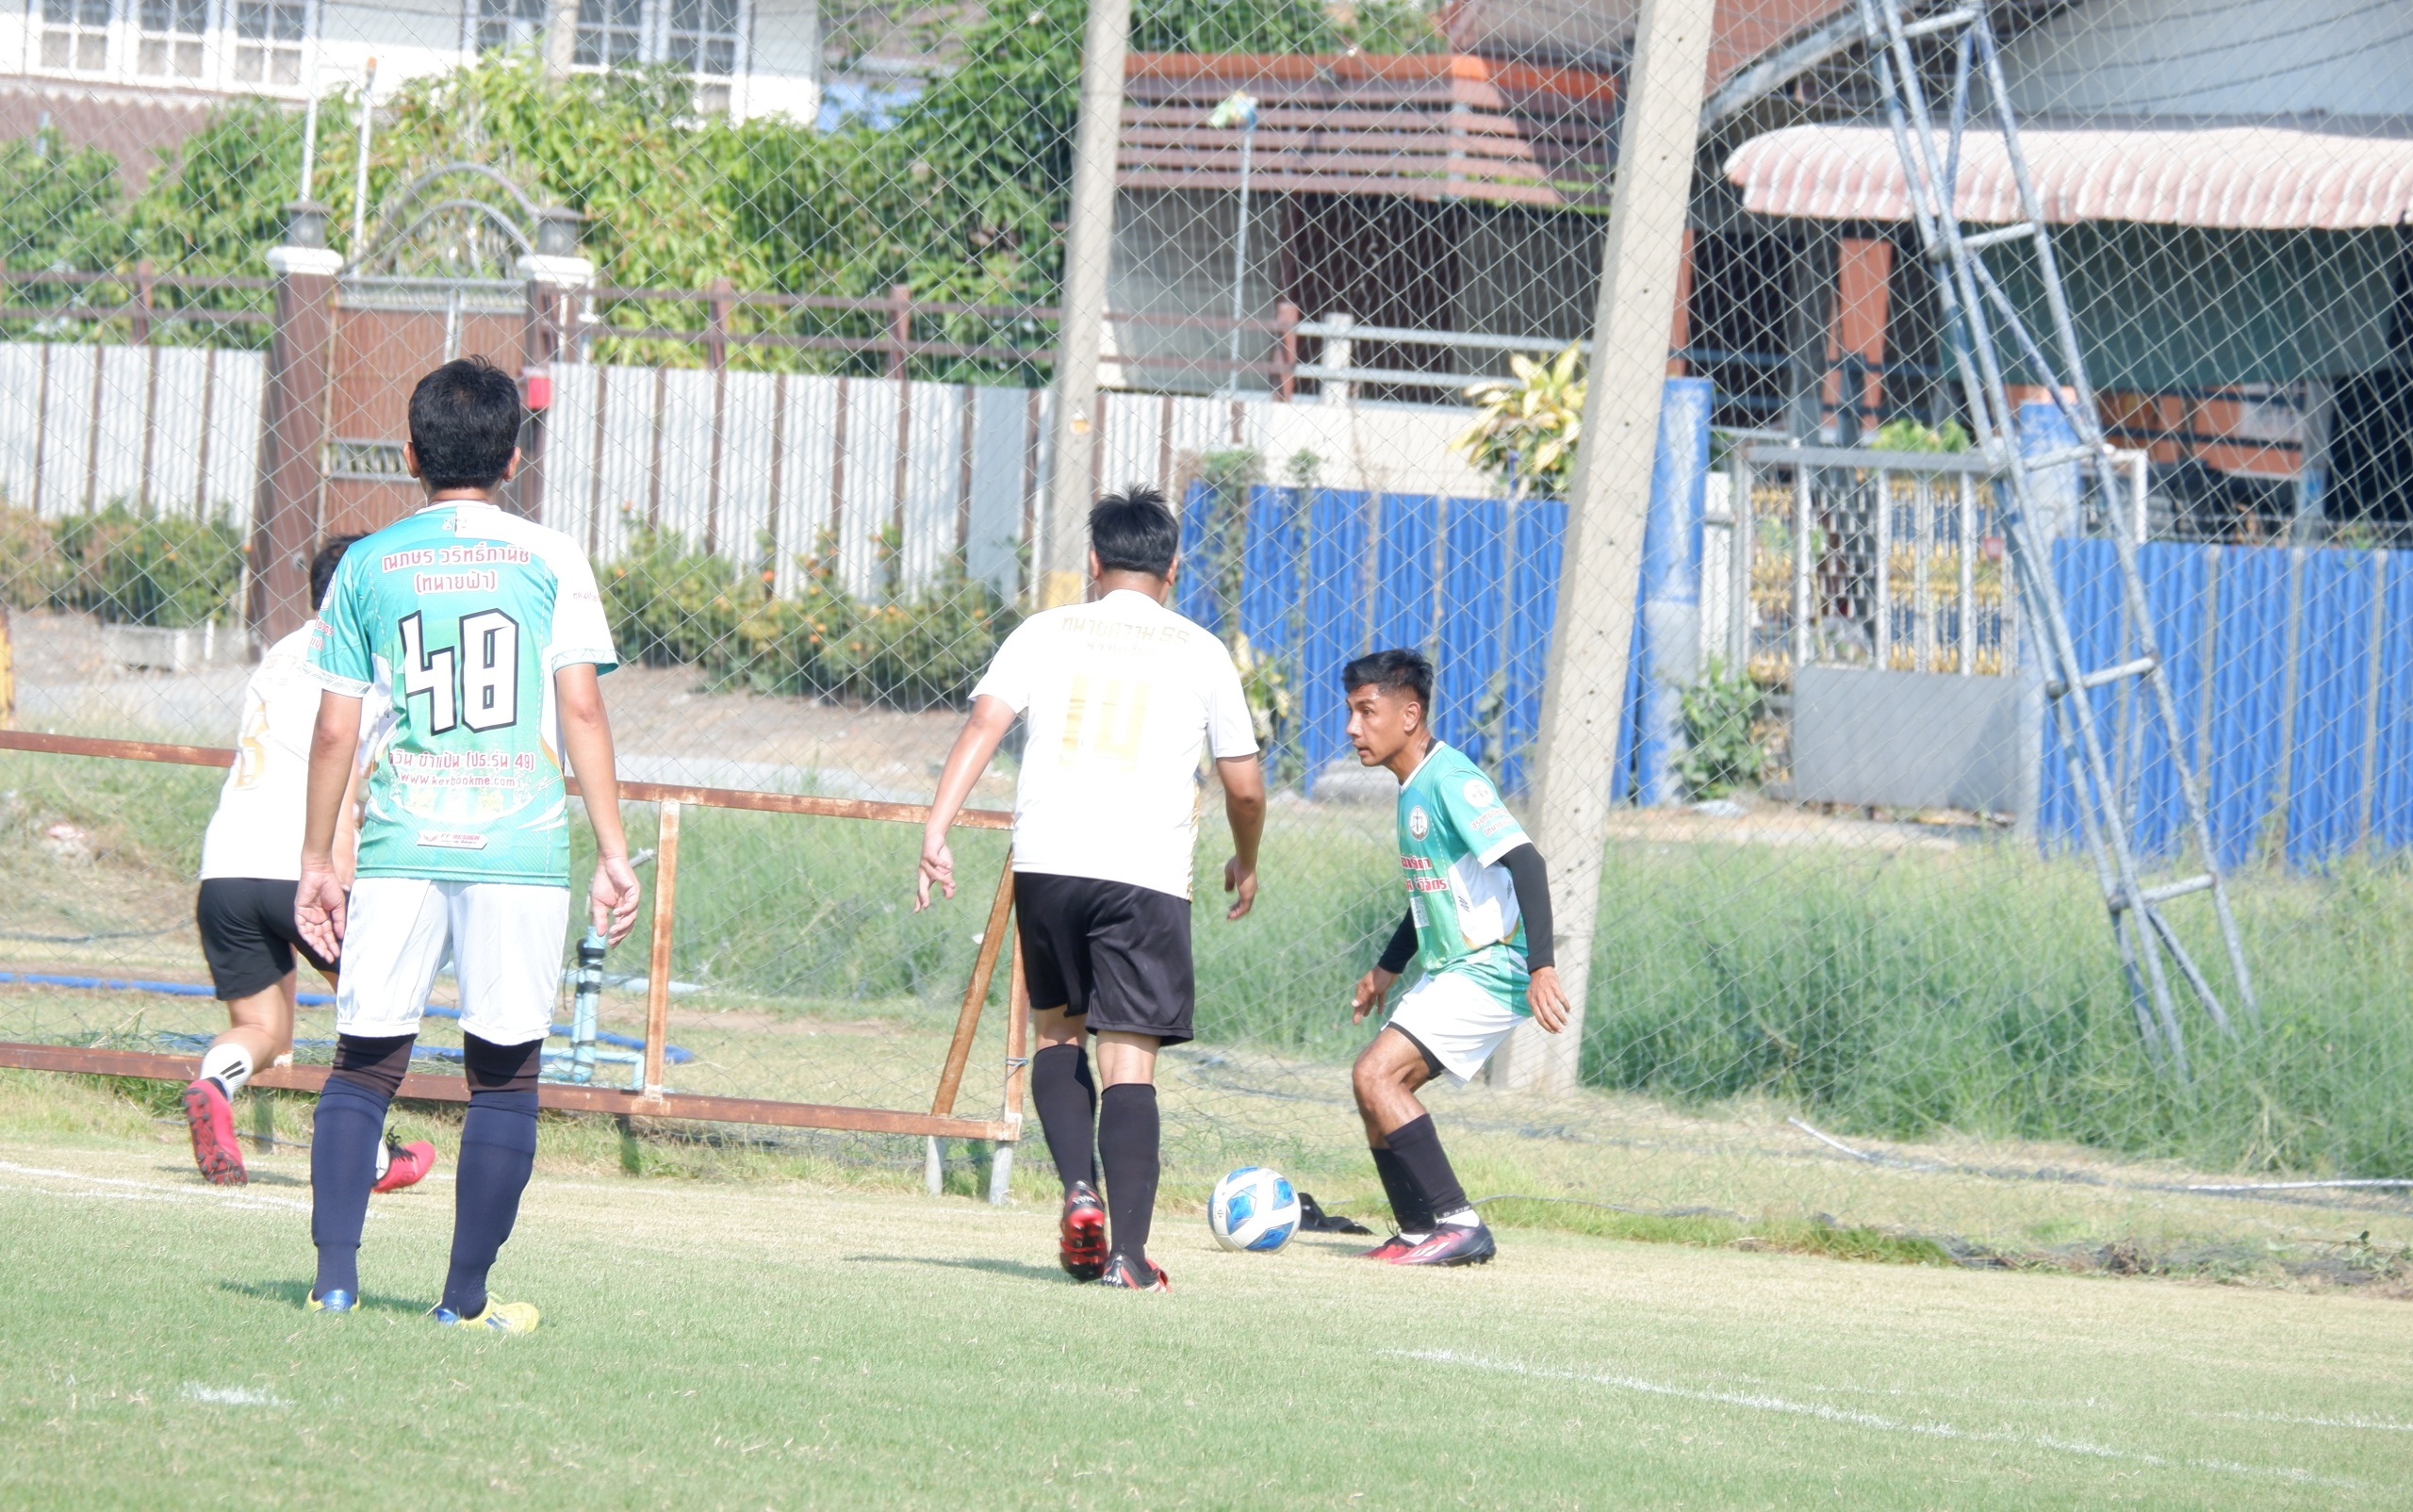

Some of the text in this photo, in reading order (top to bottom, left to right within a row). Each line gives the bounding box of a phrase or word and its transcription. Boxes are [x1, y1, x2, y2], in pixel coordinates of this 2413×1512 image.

[416, 570, 496, 593] (ทนายฟ้า)
[398, 608, 519, 735] 48
